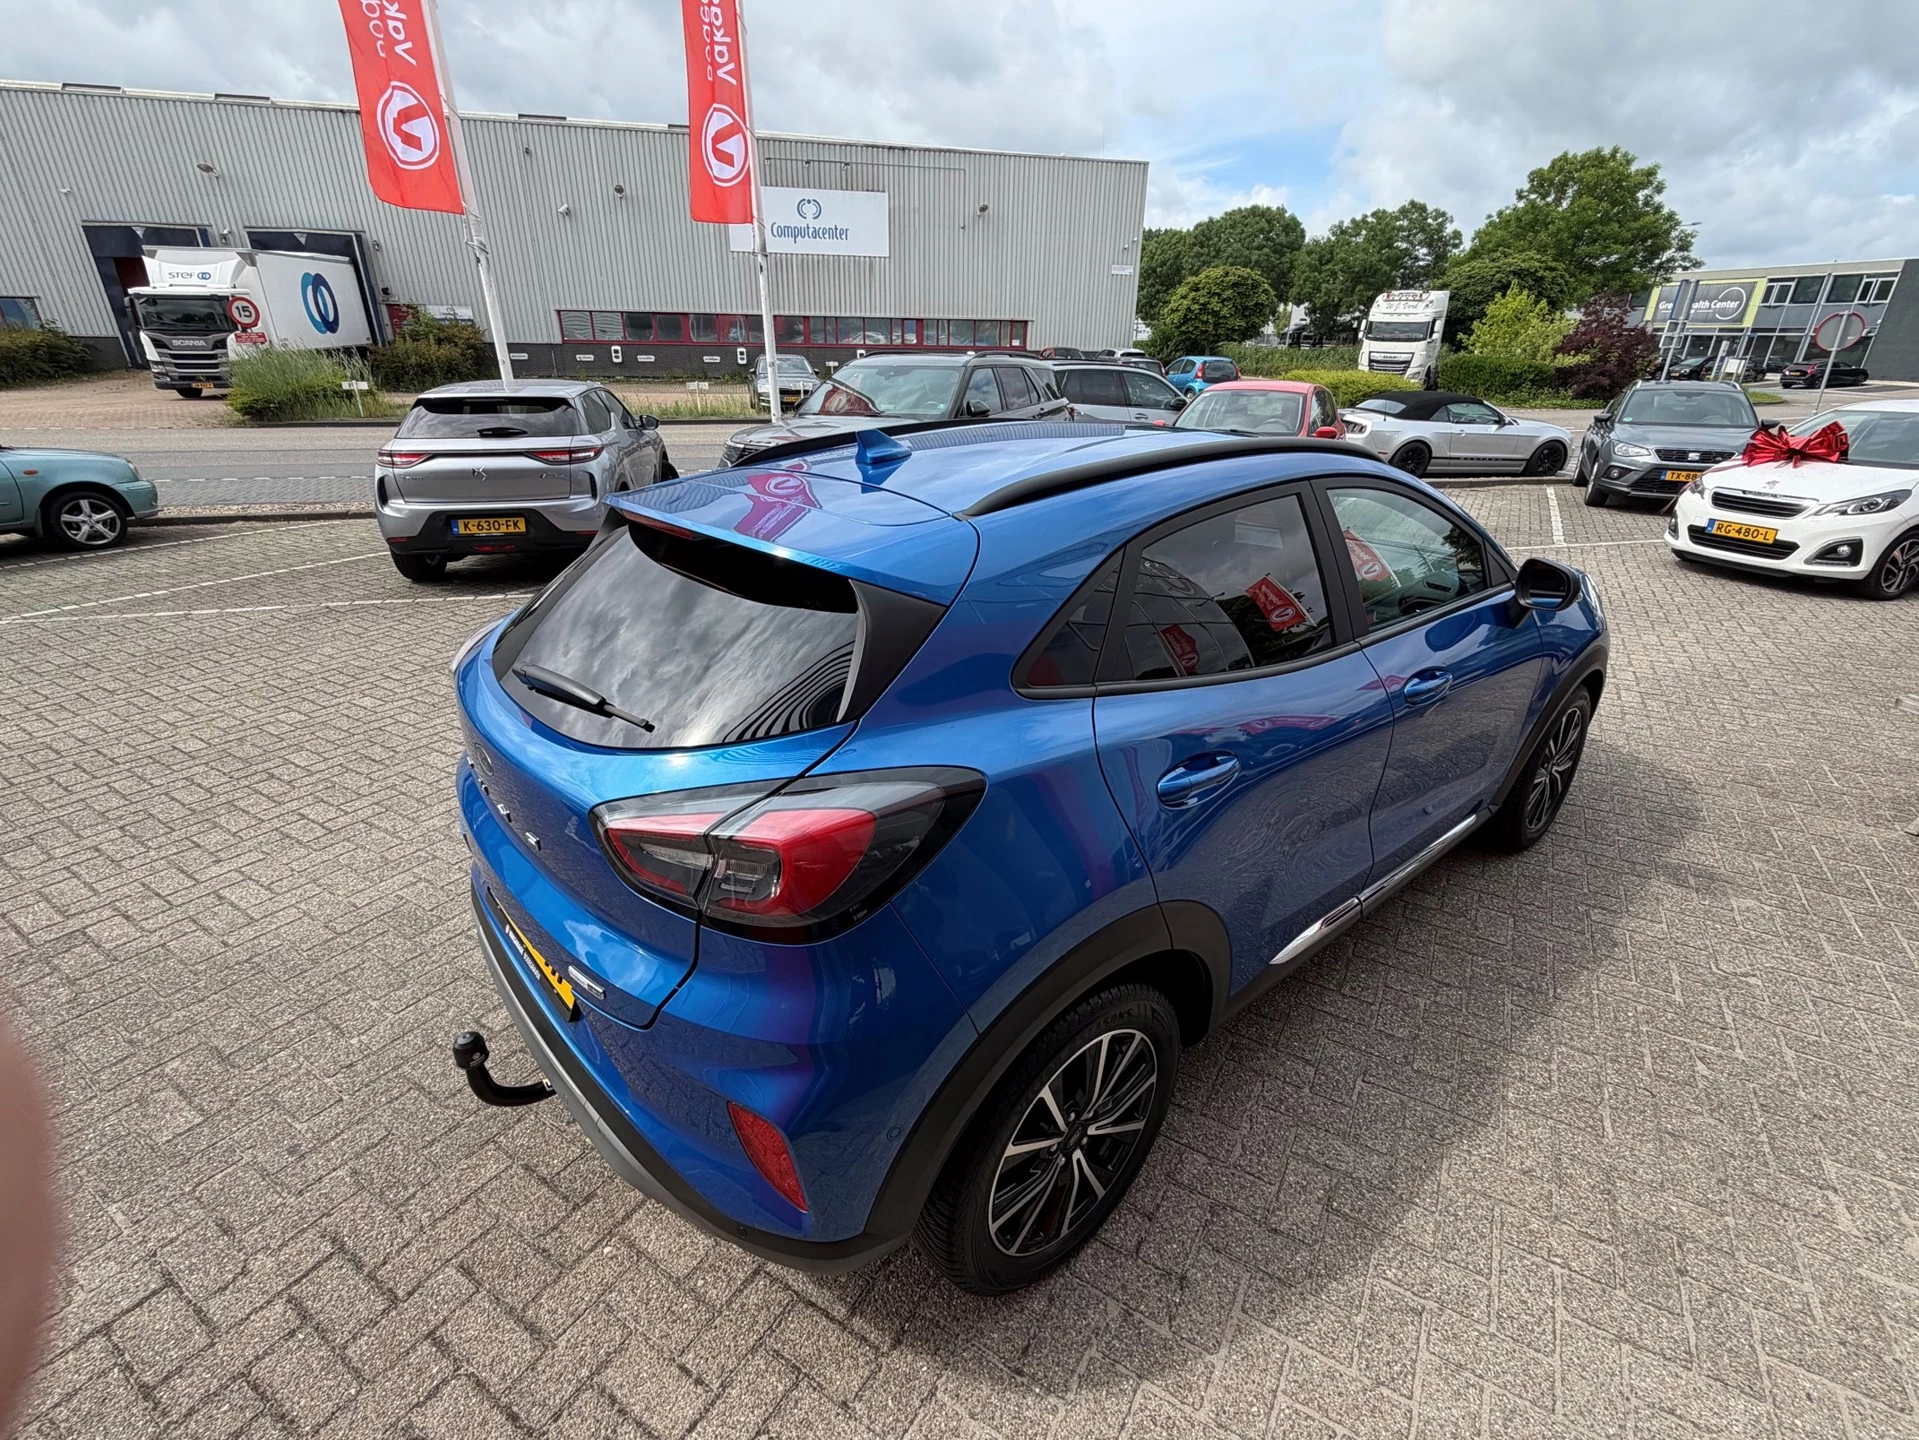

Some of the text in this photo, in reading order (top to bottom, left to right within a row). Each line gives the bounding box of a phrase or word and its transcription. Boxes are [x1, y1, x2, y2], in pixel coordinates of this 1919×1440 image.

[771, 222, 849, 244] Computacenter
[1711, 300, 1740, 308] Center
[235, 305, 252, 318] 15
[463, 518, 521, 531] K-630-FK
[1716, 523, 1770, 541] RG-480-L
